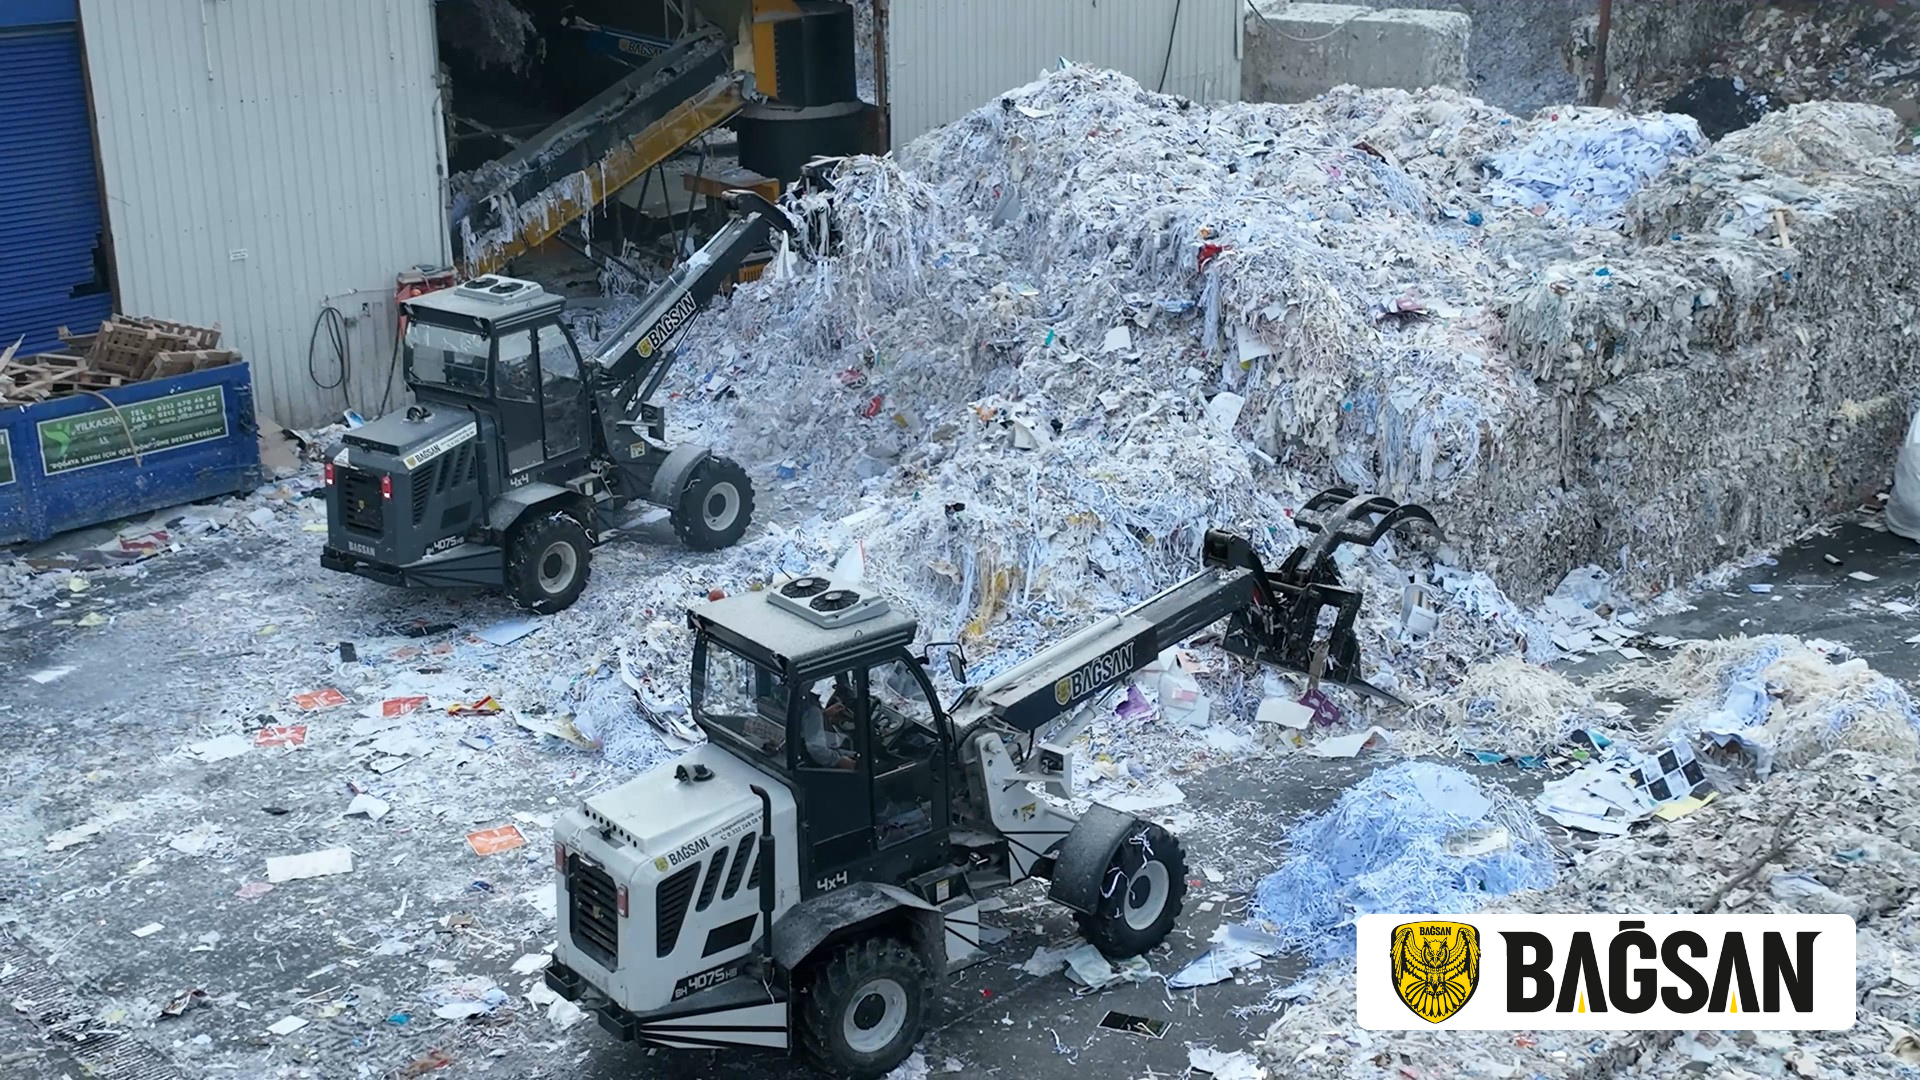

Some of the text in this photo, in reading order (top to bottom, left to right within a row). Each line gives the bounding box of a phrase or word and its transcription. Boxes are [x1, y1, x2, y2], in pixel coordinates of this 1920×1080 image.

[816, 870, 848, 891] 4x4
[675, 988, 688, 998] BH
[688, 967, 725, 990] 4075
